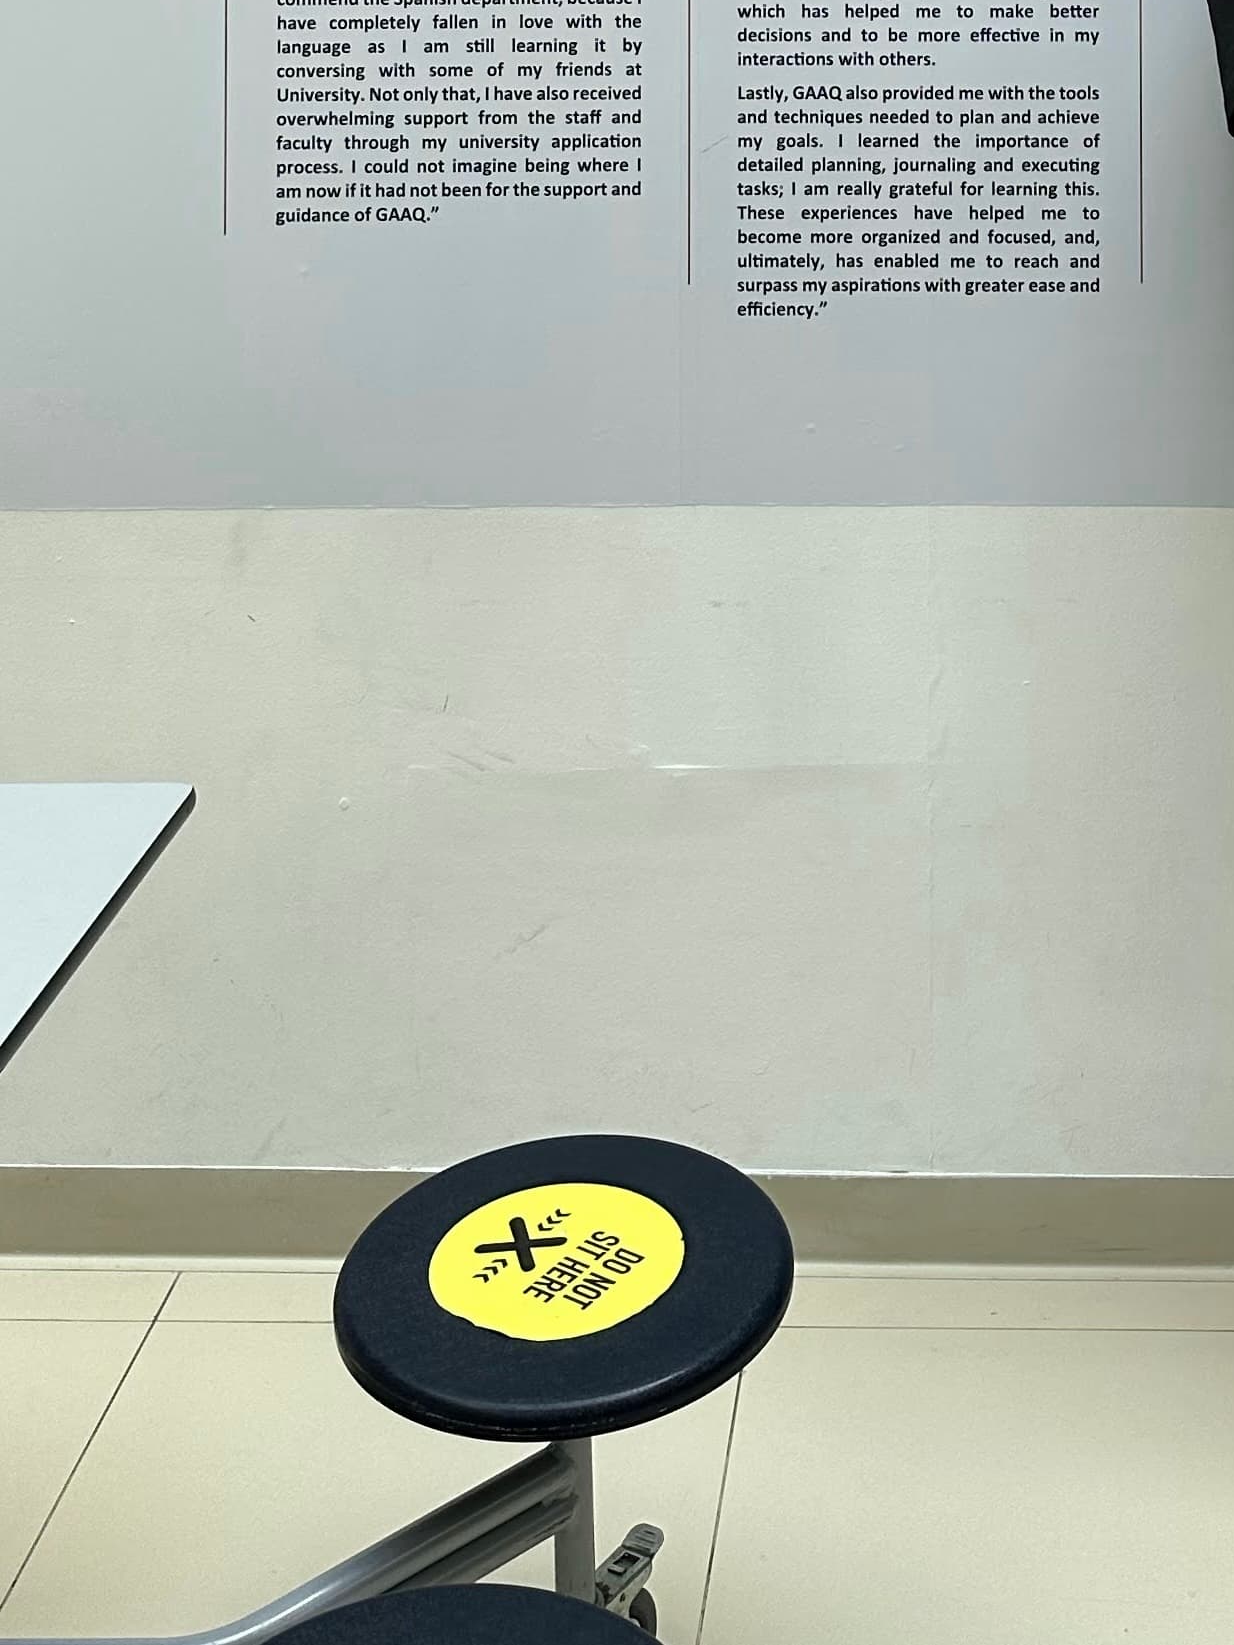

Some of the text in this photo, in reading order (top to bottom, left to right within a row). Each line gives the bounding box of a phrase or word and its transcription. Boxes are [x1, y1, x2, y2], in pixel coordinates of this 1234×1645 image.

[738, 51, 935, 66] interactions with others.
[276, 207, 349, 226] guidance
[355, 207, 372, 221] of
[523, 1231, 620, 1303] SIT HERE
[563, 1248, 645, 1310] DO NOT
